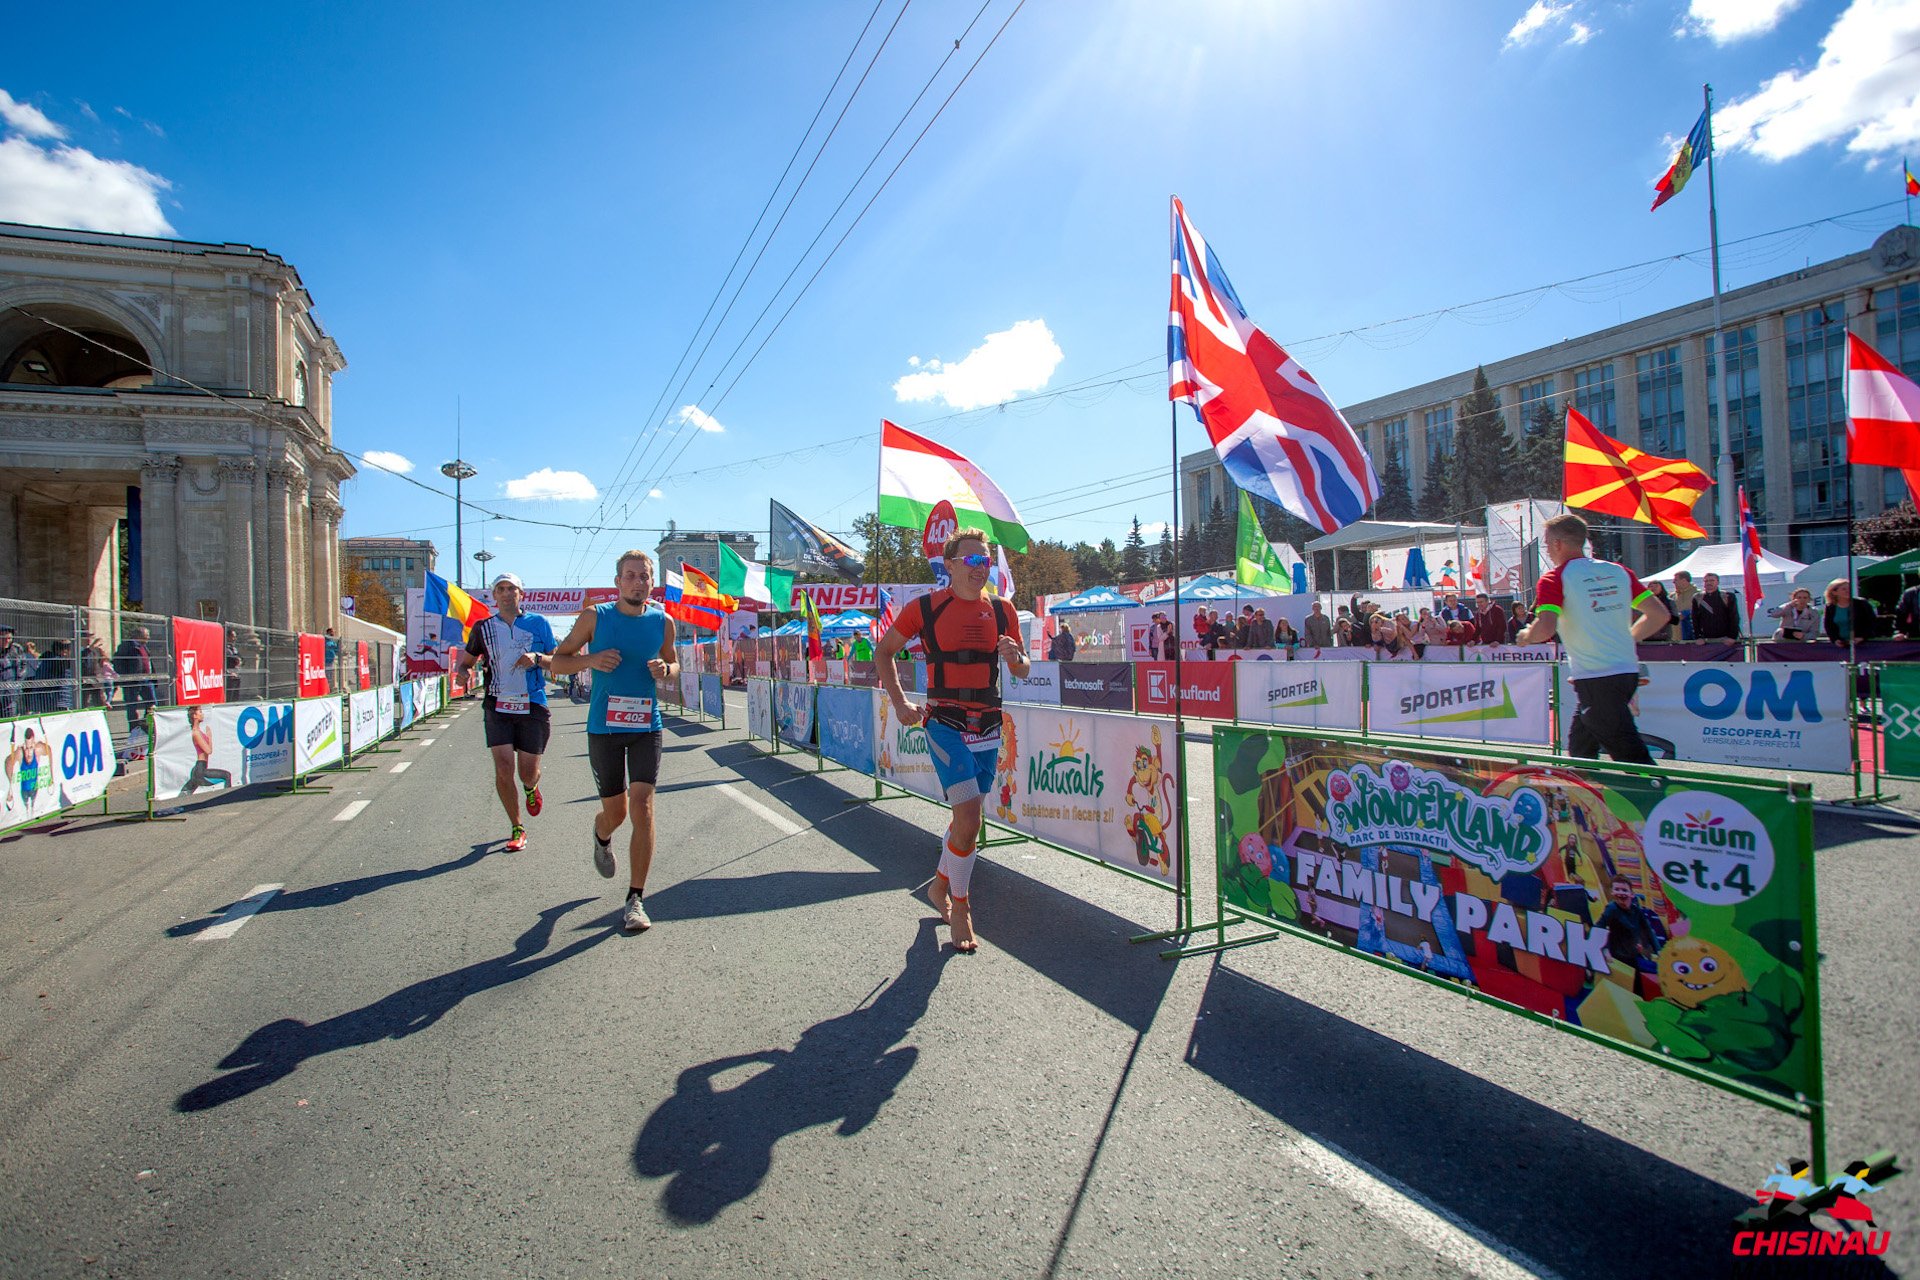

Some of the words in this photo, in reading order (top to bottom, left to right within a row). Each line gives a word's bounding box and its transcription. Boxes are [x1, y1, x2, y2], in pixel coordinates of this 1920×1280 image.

[521, 591, 582, 602] HISINAU
[790, 586, 877, 607] FINISH
[1069, 592, 1115, 607] OM
[1193, 583, 1241, 598] OM
[519, 603, 559, 611] ARATHON
[560, 603, 580, 611] 2018
[842, 615, 872, 627] OM
[199, 669, 223, 690] Kaufland
[1064, 678, 1104, 691] technosoft
[1169, 684, 1220, 702] Kaufland
[1268, 679, 1318, 702] SPORTER
[1400, 680, 1496, 715] SPORTER
[1683, 668, 1823, 722] OM
[510, 703, 525, 711] 376
[614, 712, 622, 721] C
[624, 713, 646, 723] 402
[237, 705, 294, 749] OM
[306, 711, 334, 751] SPORTER
[896, 726, 930, 757] Natura
[1702, 737, 1751, 747] VERSIUNEA
[61, 729, 104, 780] OM
[16, 768, 38, 783] EROU
[1028, 751, 1105, 798] Naturalis
[1334, 772, 1543, 868] WONDERLAND
[1350, 832, 1376, 845] PARC
[1378, 830, 1392, 840] DE
[1394, 831, 1449, 848] DISTRACTII
[1662, 858, 1757, 898] et.4
[1296, 851, 1440, 923] FAMILY
[1455, 891, 1611, 975] PARK
